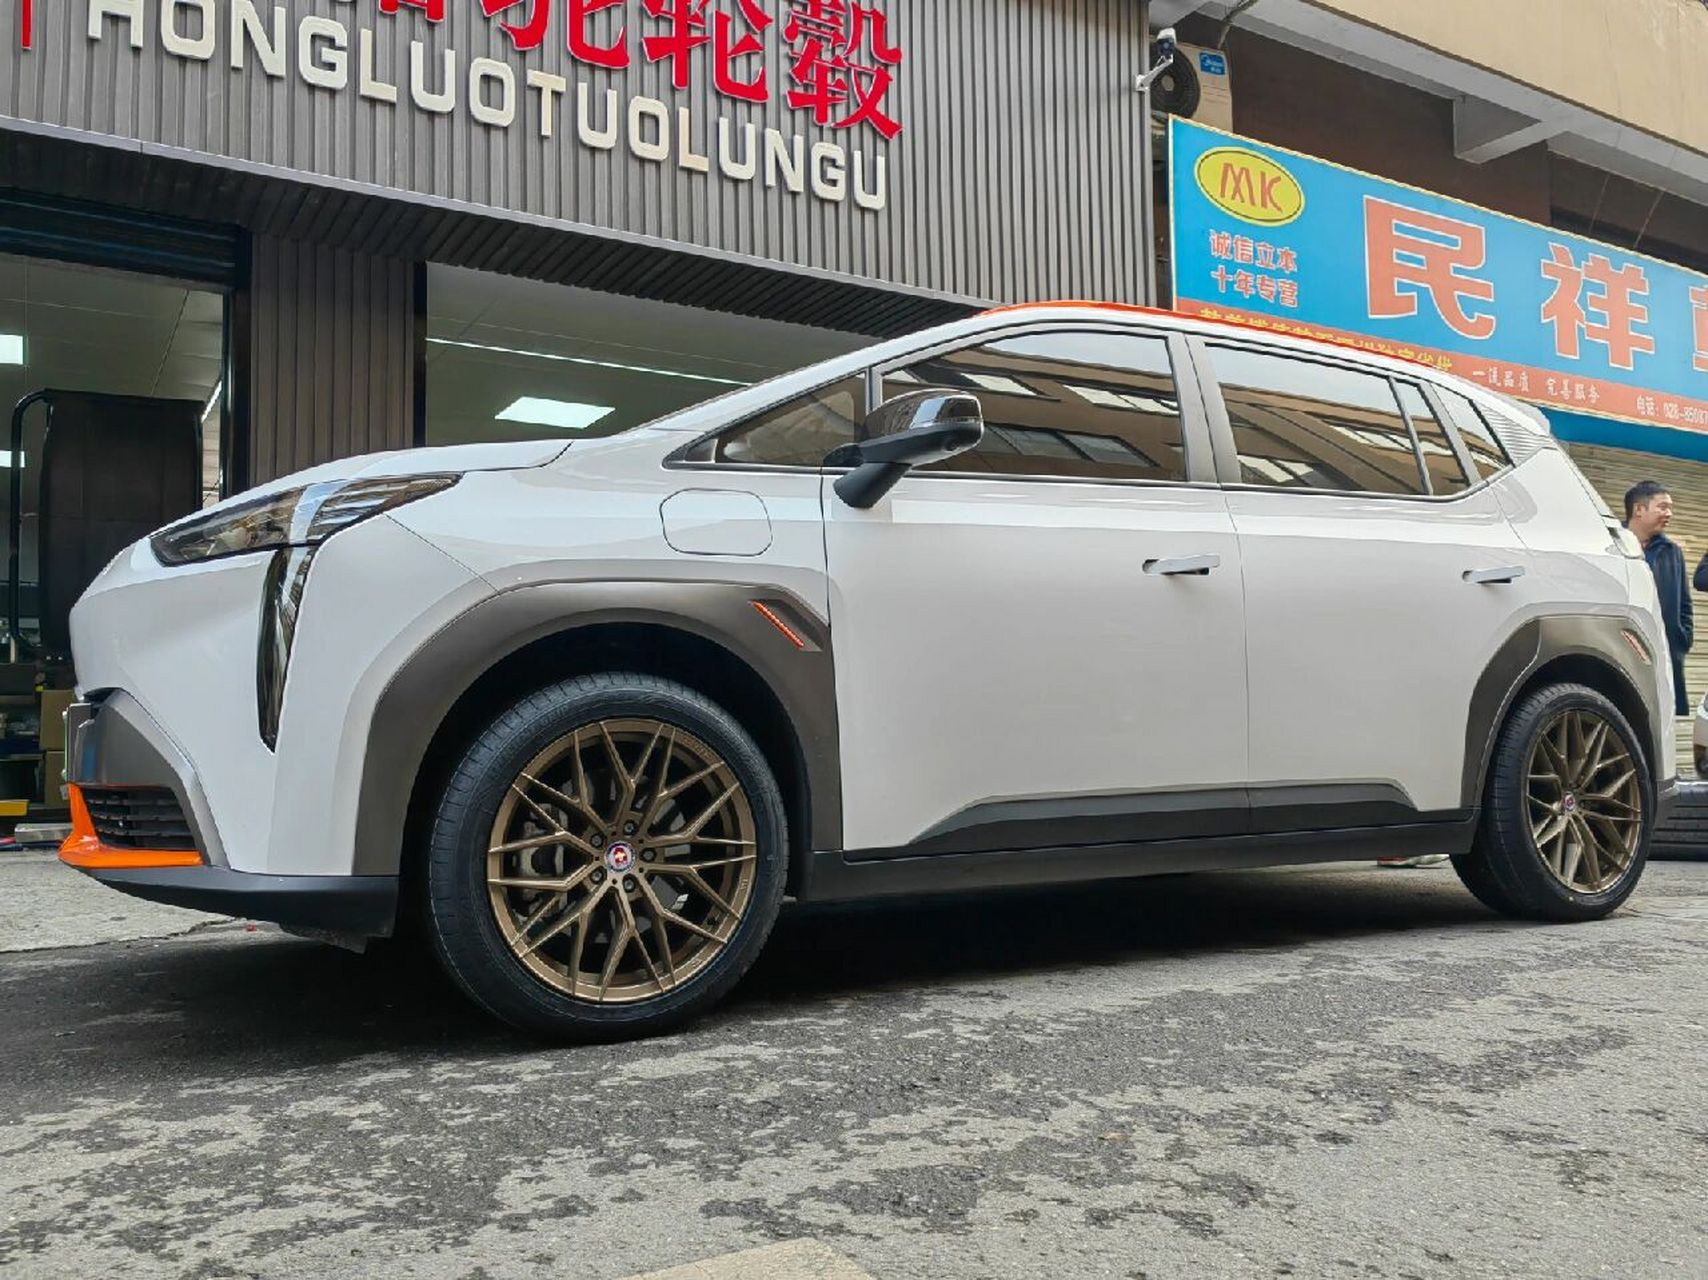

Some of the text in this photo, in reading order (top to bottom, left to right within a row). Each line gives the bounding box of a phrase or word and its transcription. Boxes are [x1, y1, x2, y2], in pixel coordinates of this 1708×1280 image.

[88, 0, 885, 210] HONGLUOTUOLUNGU
[1220, 162, 1282, 214] MK
[1209, 229, 1298, 273] 诚信立本
[1210, 265, 1299, 308] 十年专营
[1363, 194, 1708, 371] 民祥
